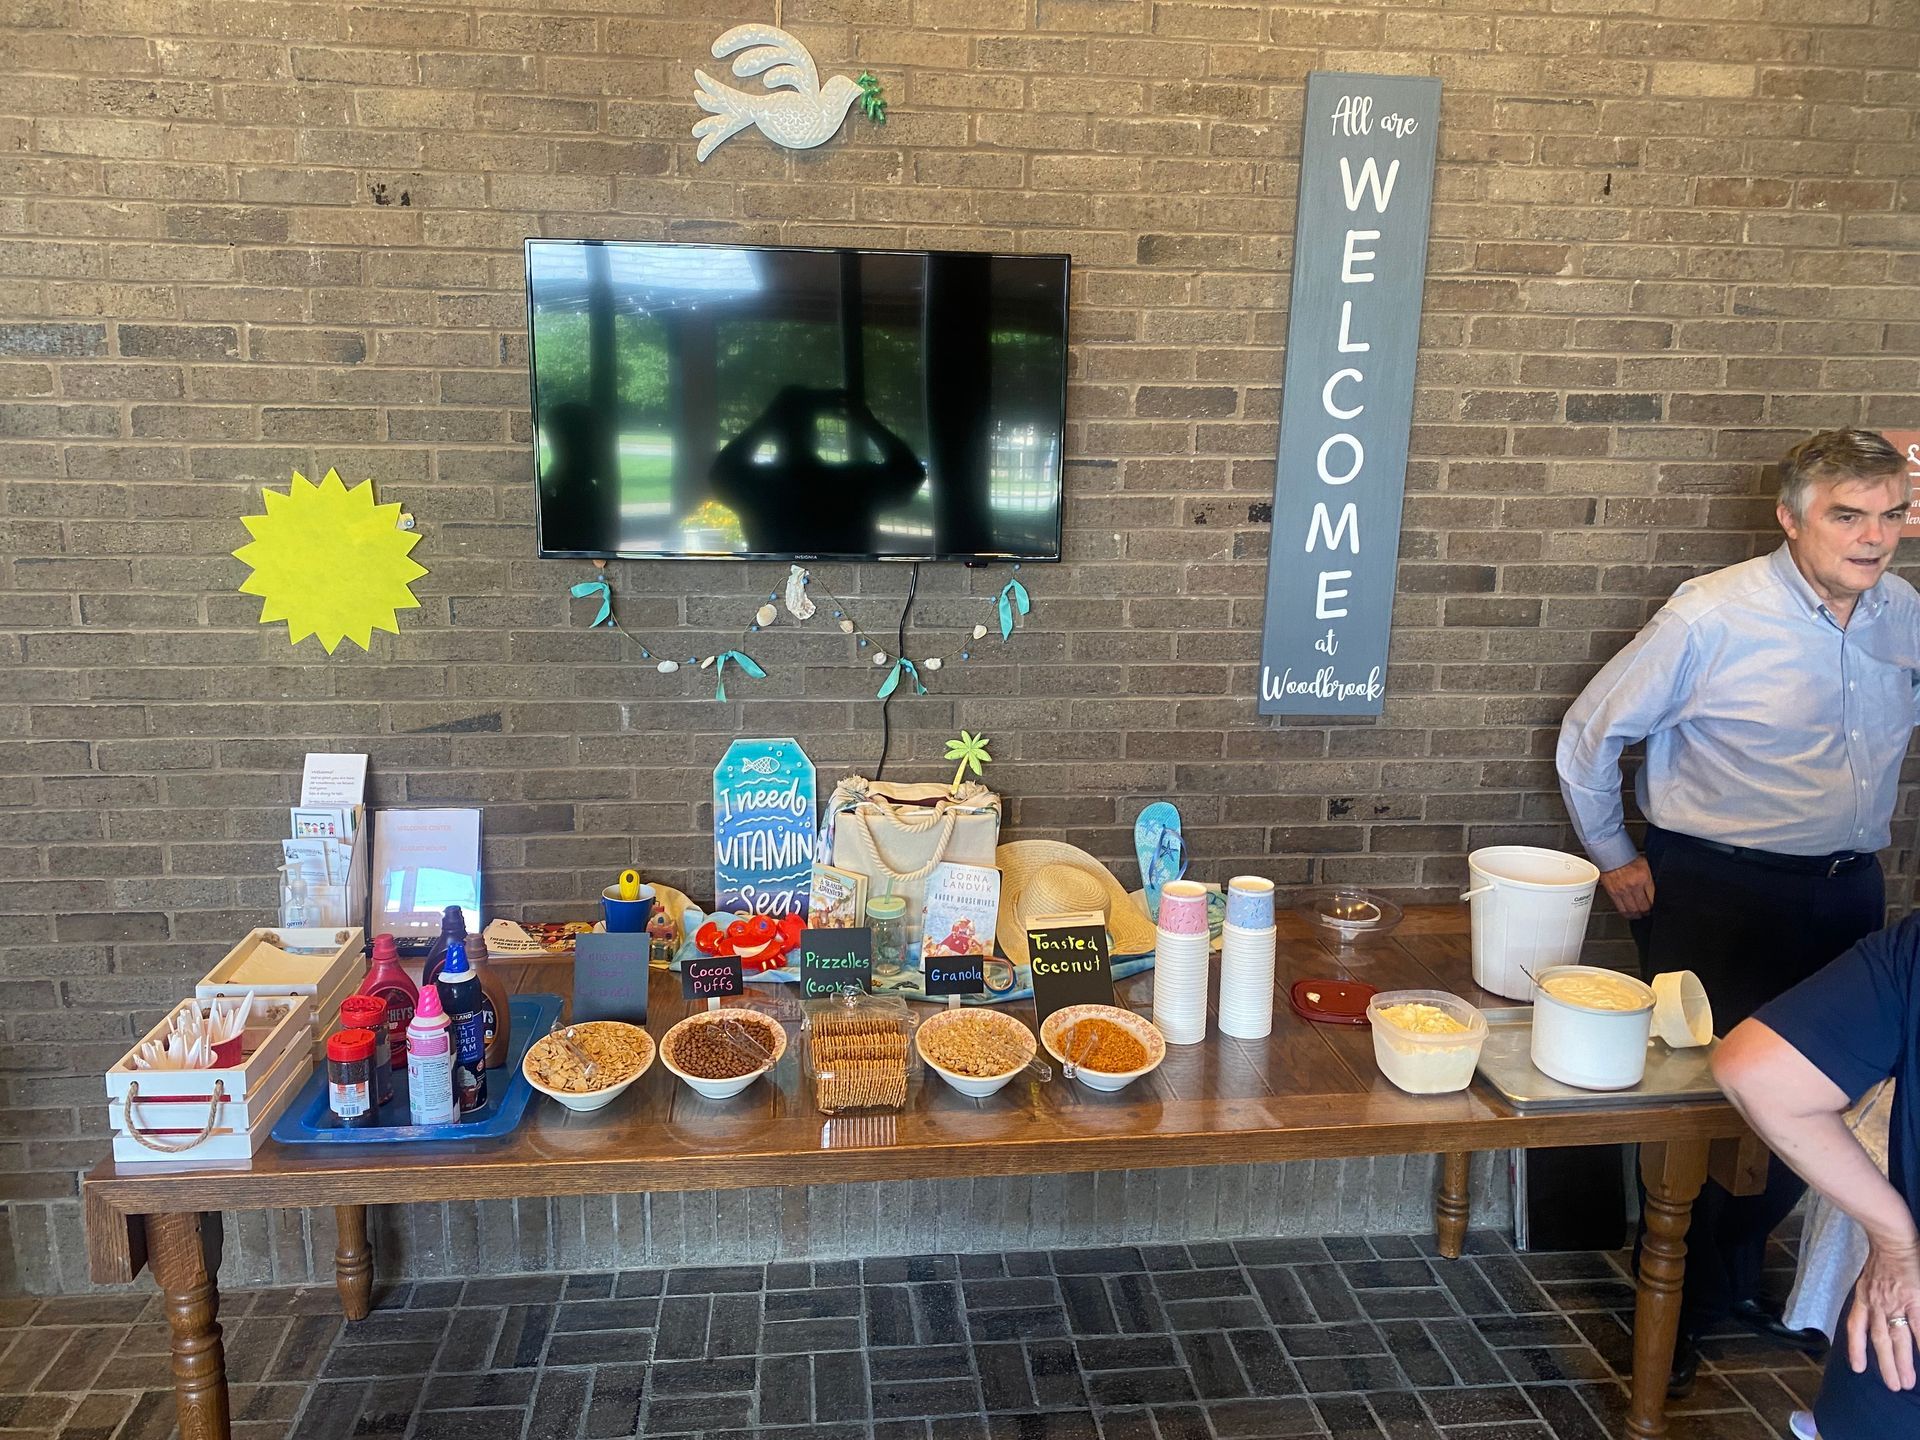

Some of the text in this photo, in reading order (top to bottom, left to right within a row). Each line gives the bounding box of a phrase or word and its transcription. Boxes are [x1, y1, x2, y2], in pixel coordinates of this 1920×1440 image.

[1331, 95, 1419, 139] All are
[1304, 156, 1401, 620] WELCOME
[1315, 628, 1339, 656] at
[1262, 665, 1385, 702] Woodbrook
[719, 776, 807, 823] I need
[716, 828, 814, 872] VITAMIN
[943, 878, 993, 893] LANDVIK
[949, 870, 989, 884] LORNA
[739, 883, 804, 918] Sea
[934, 892, 996, 908] ANGRY HOUSEWIVES
[1029, 933, 1099, 951] Toasted
[805, 951, 870, 969] Pizzelles
[1032, 955, 1101, 975] Coconut
[690, 963, 734, 978] Cocoa
[931, 966, 983, 982] Granola
[693, 977, 733, 994] Puffs
